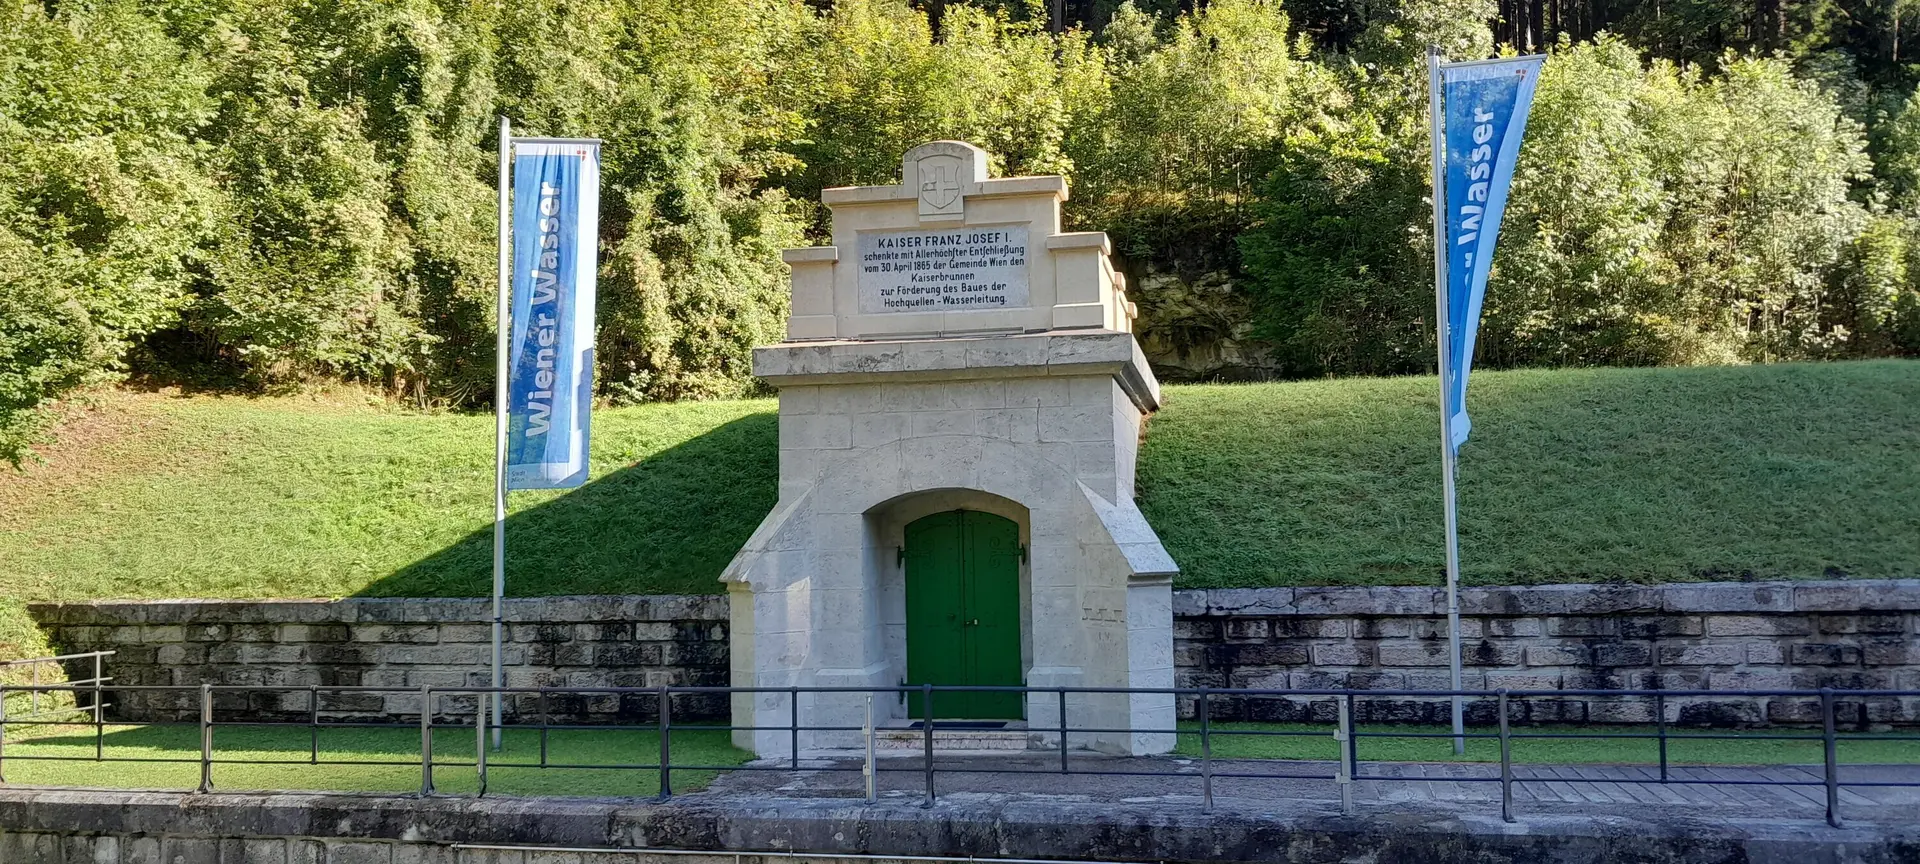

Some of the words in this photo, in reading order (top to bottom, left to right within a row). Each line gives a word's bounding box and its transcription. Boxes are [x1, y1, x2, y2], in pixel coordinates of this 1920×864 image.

[1457, 106, 1494, 246] Wasser
[531, 181, 561, 305] Wasser
[878, 237, 922, 249] KAISER
[925, 234, 961, 247] FRANZ
[965, 232, 1001, 245] JOSEF
[1005, 232, 1012, 243] I.
[864, 251, 899, 261] schenkte
[901, 249, 914, 260] mit
[864, 265, 879, 273] vom
[893, 262, 912, 274] April
[914, 261, 931, 271] 1865
[933, 260, 947, 270] der
[949, 258, 987, 269] Gemeinde
[989, 257, 1007, 267] Wien
[1010, 256, 1025, 266] den
[911, 271, 975, 283] Kaiserbrunnen
[880, 289, 895, 297] zur
[897, 284, 941, 297] Förderung
[943, 283, 958, 293] des
[961, 282, 988, 292] Baues
[991, 281, 1007, 291] der
[526, 317, 555, 439] Wiener
